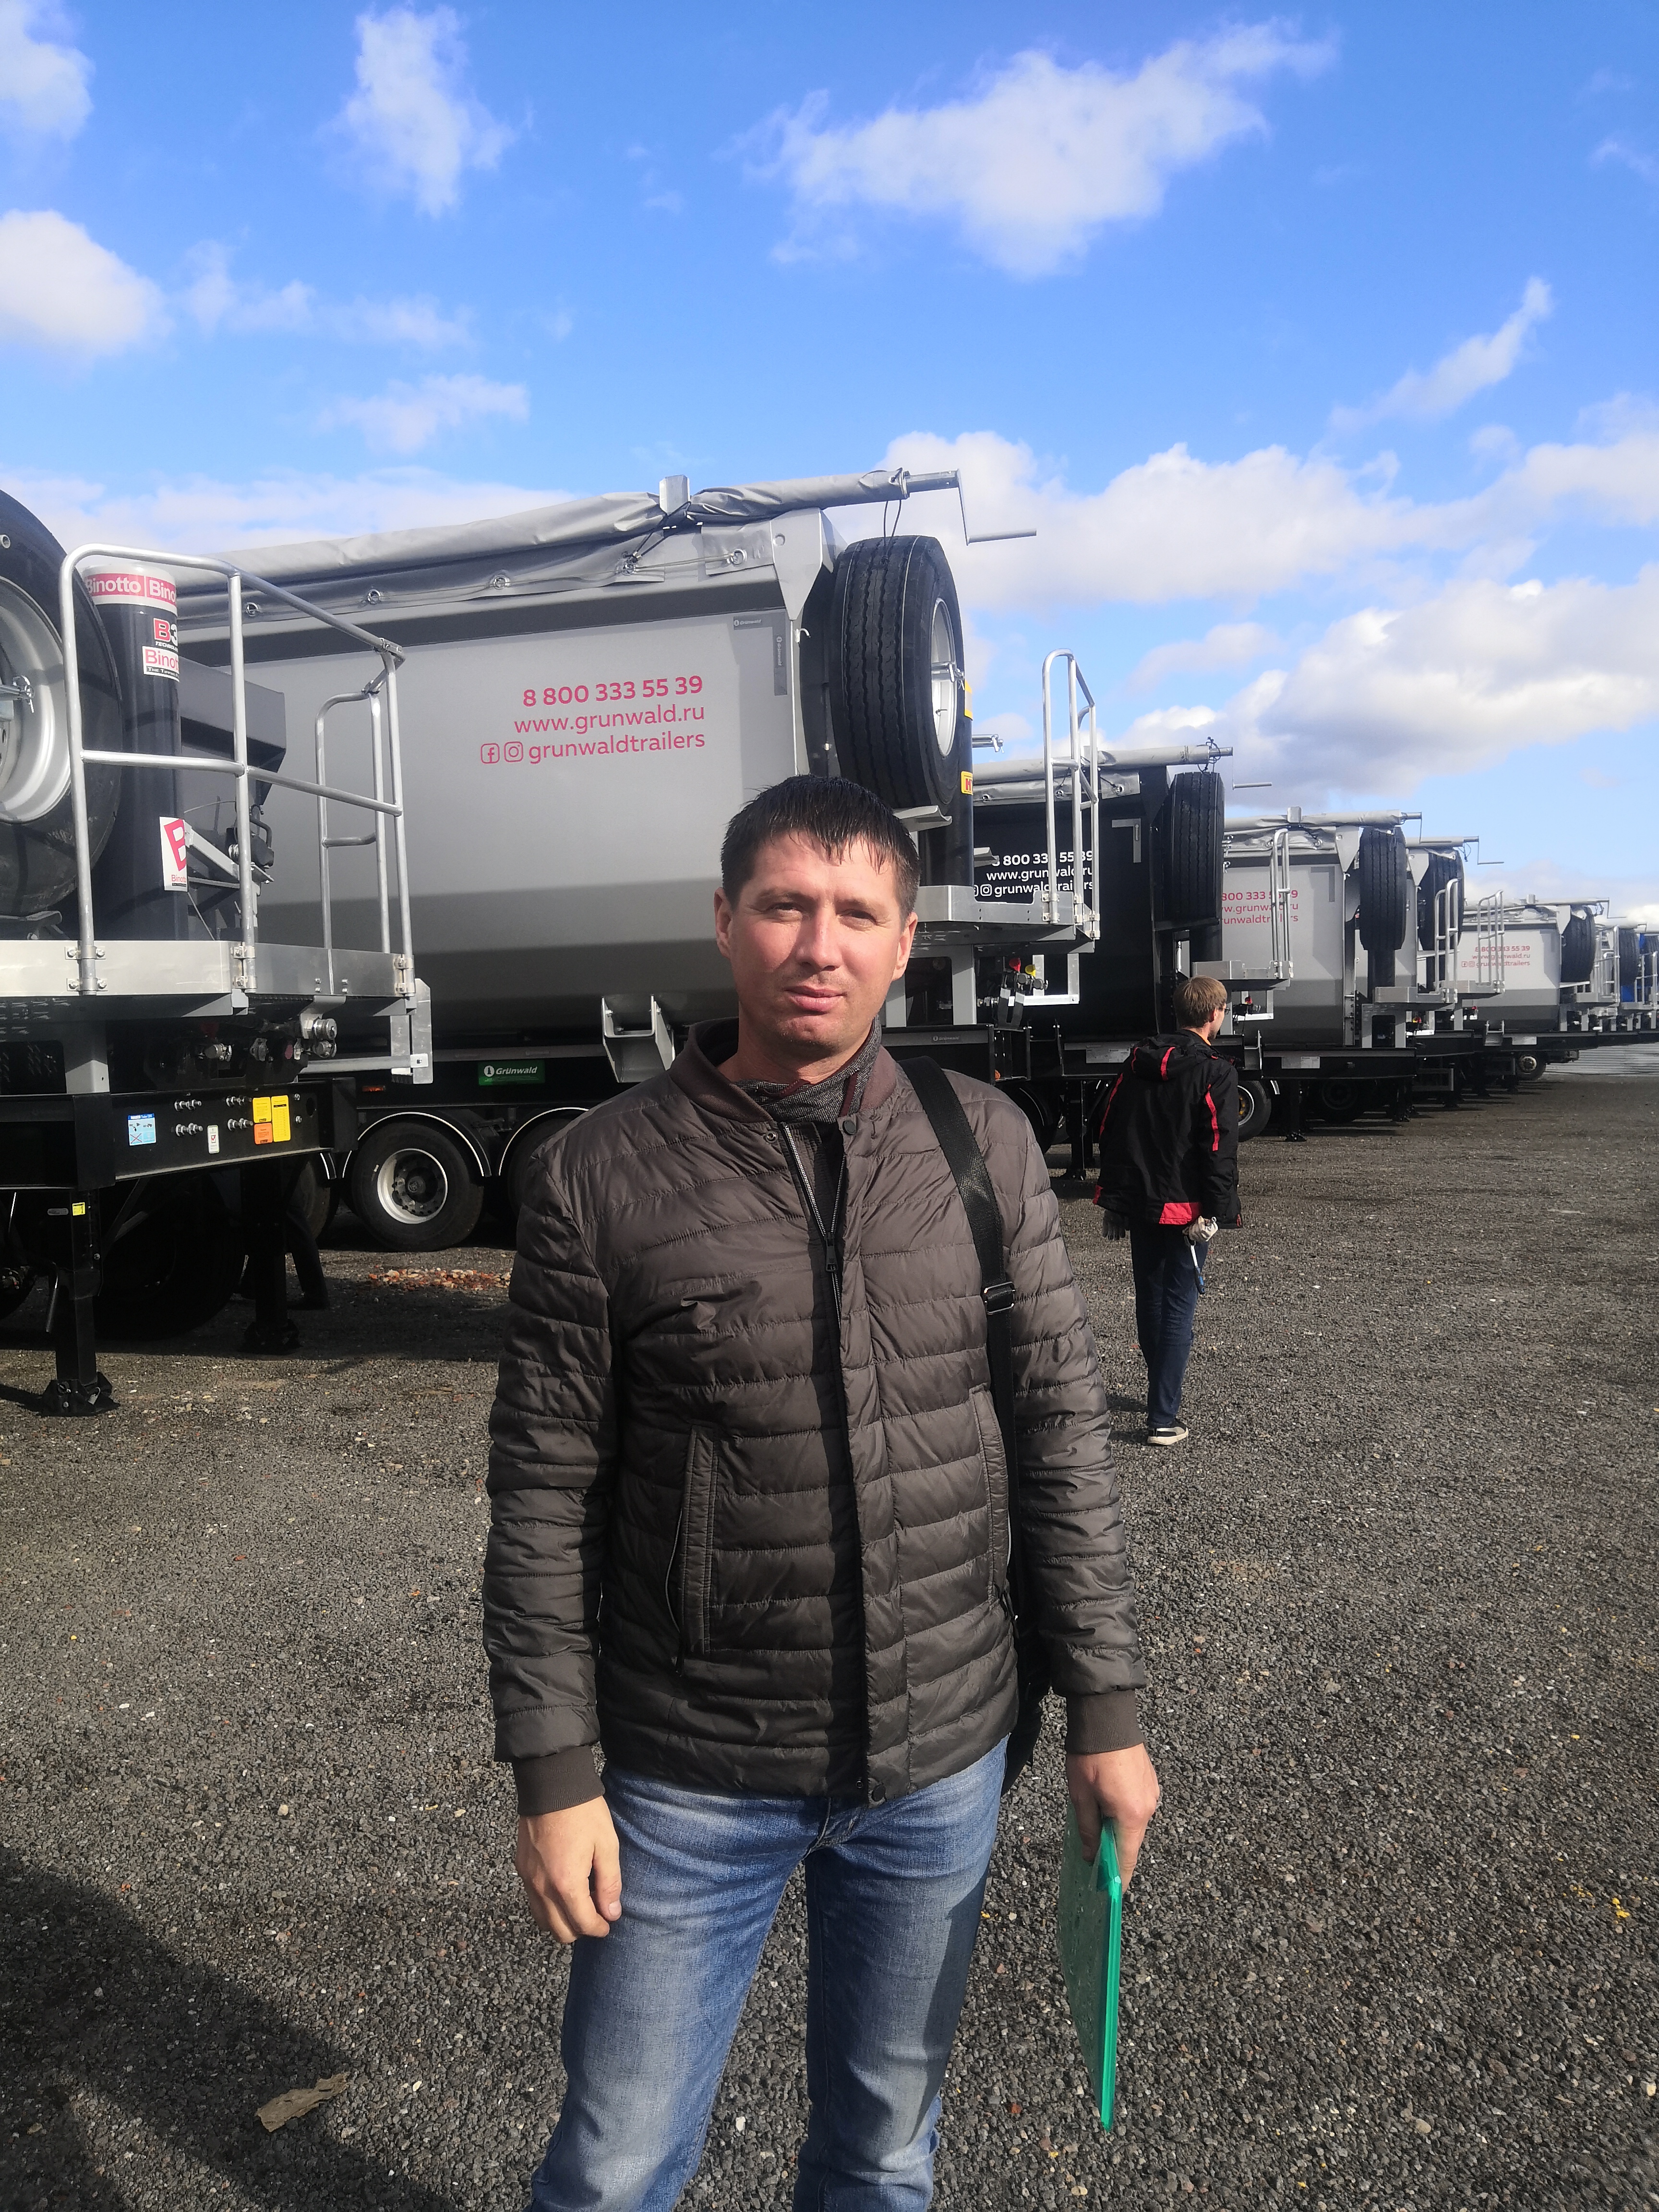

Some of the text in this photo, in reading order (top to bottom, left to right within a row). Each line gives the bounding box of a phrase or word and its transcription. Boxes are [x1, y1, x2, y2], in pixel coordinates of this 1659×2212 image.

[85, 577, 142, 593] Binotto
[523, 675, 703, 707] 8 800 333 55 39
[514, 704, 705, 734] www.grunwald.ru
[529, 731, 705, 765] grunwaldtrailers
[1003, 854, 1030, 866] 800
[1059, 852, 1074, 863] 55
[1246, 891, 1265, 900] 333
[496, 1066, 538, 1075] Grünwald
